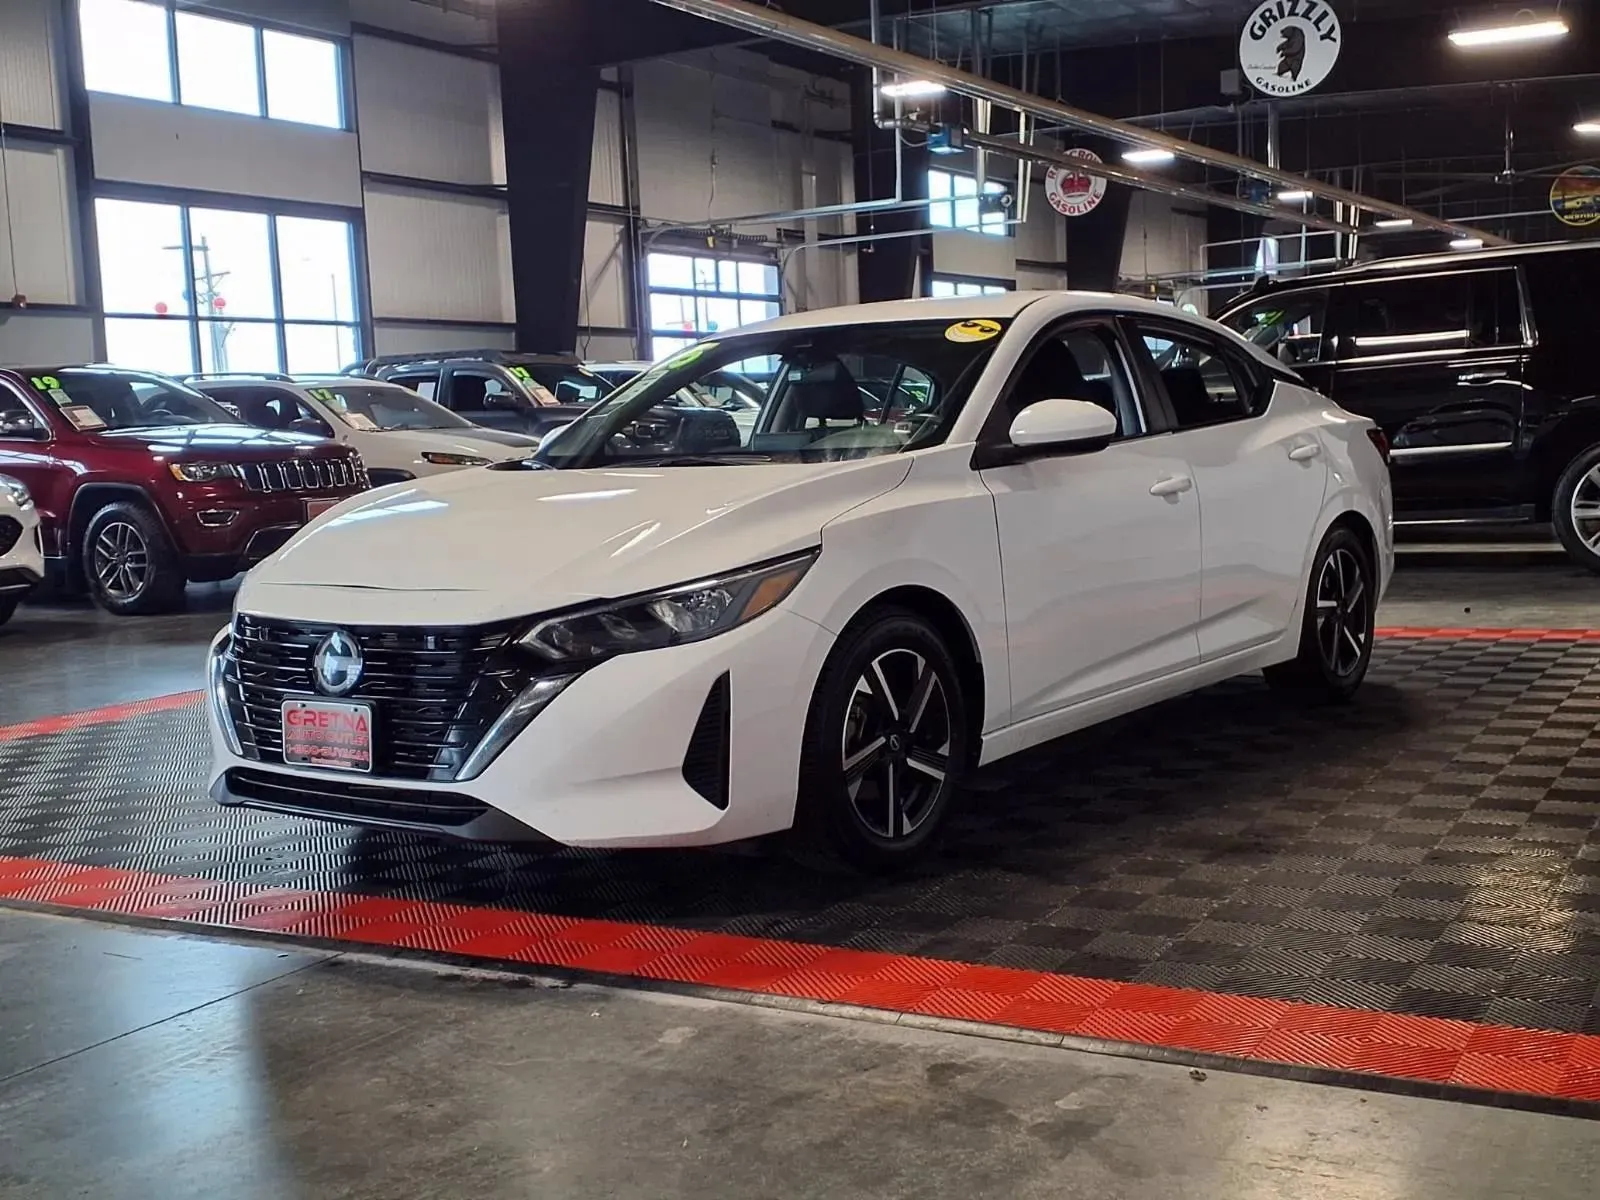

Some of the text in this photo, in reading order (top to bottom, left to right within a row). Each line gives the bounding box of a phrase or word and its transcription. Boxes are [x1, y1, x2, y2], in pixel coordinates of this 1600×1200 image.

[1249, 0, 1336, 42] GRIZZLY
[1255, 76, 1311, 93] GASOLINE
[1049, 190, 1102, 214] GASOLINE
[31, 376, 60, 389] 19
[287, 710, 368, 732] GRETNA
[287, 728, 368, 747] AUTO OUTLET
